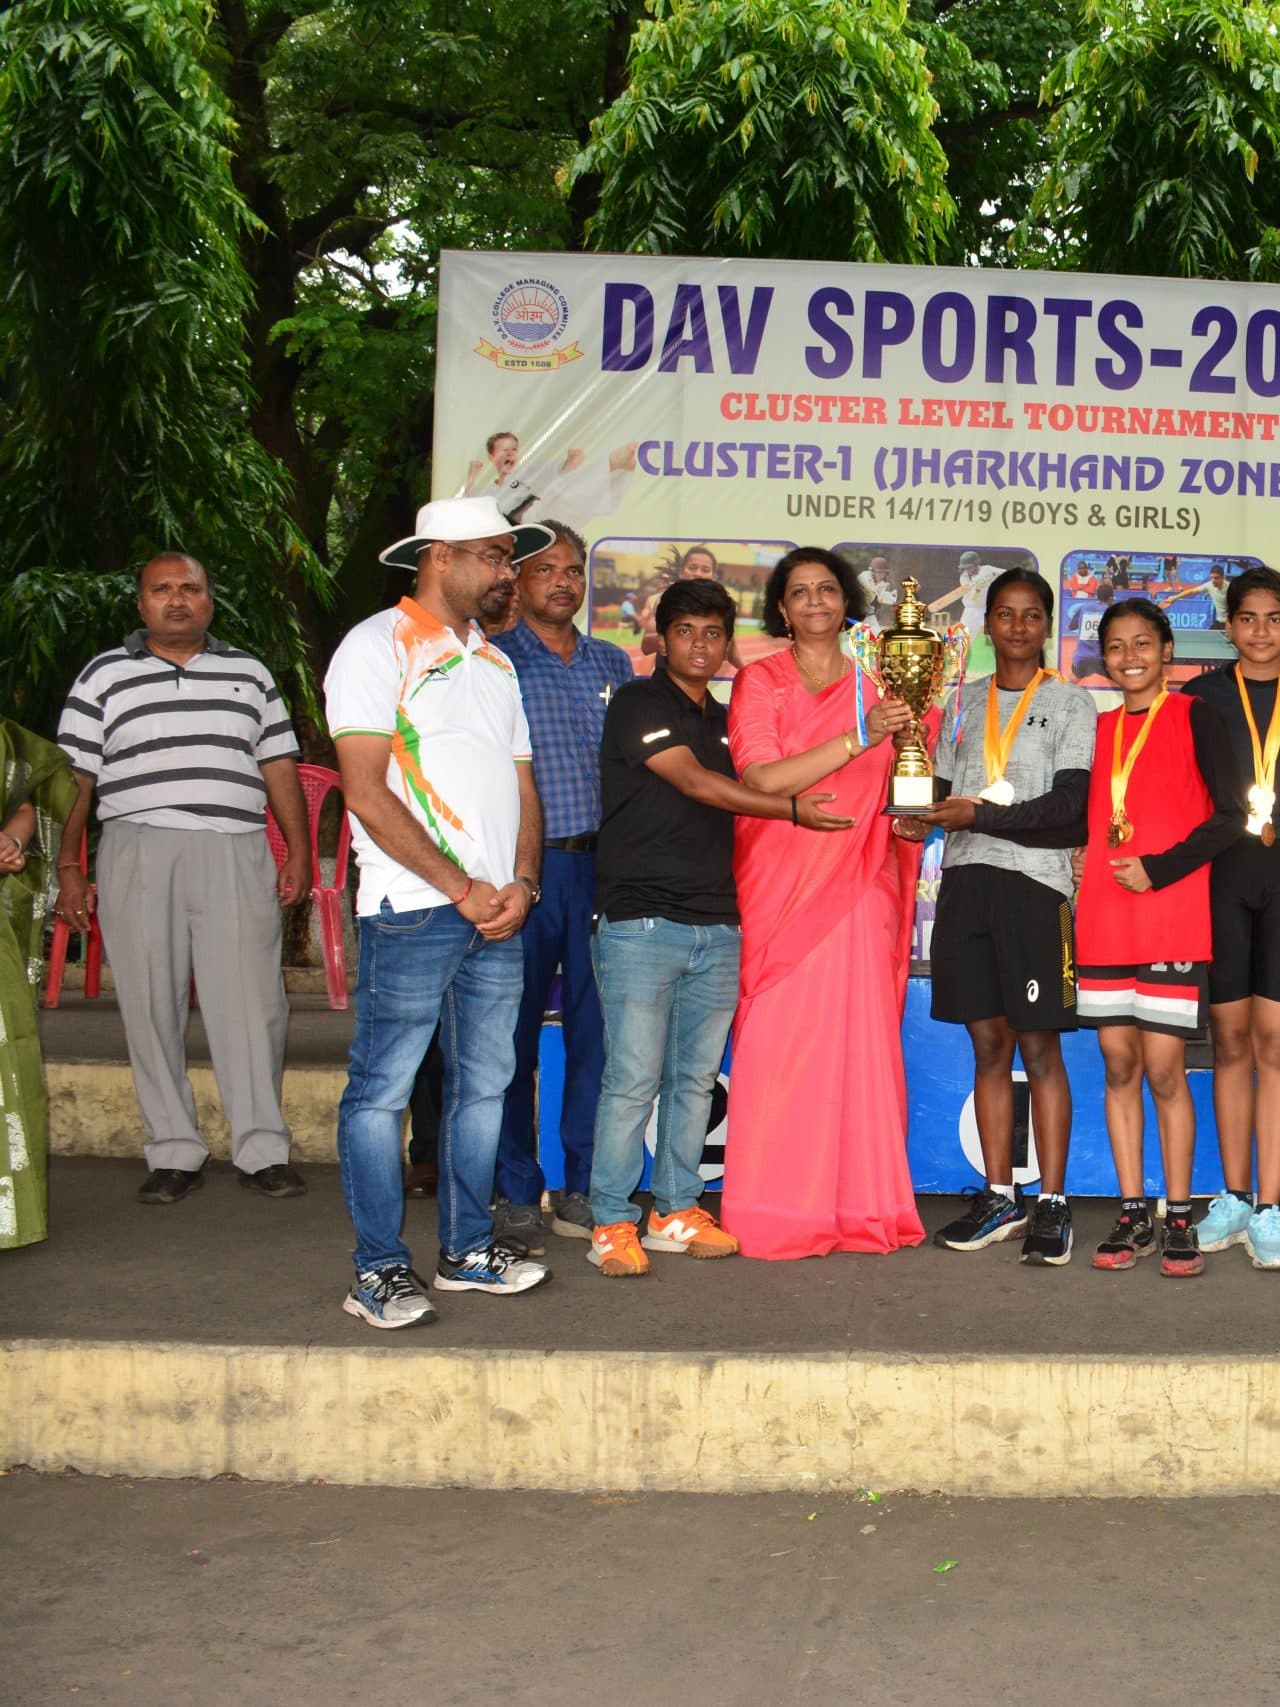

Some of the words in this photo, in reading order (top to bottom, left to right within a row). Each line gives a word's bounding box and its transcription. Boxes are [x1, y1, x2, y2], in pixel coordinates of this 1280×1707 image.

[492, 283, 514, 317] COLLEGE
[516, 278, 560, 296] MANAGING
[551, 295, 569, 341] COMMITTEE
[601, 282, 774, 375] DAV
[720, 391, 888, 425] CLUSTER
[897, 397, 1015, 430] LEVEL
[1023, 401, 1280, 442] TOURNAMENT
[637, 440, 851, 484] CLUSTER-1
[873, 446, 1165, 494] (JHARKHAND
[787, 493, 876, 519] UNDER
[885, 497, 993, 523] 14/17/19
[1001, 500, 1079, 530] (BOYS
[1087, 503, 1106, 528] &
[1115, 505, 1201, 536] GIRLS)
